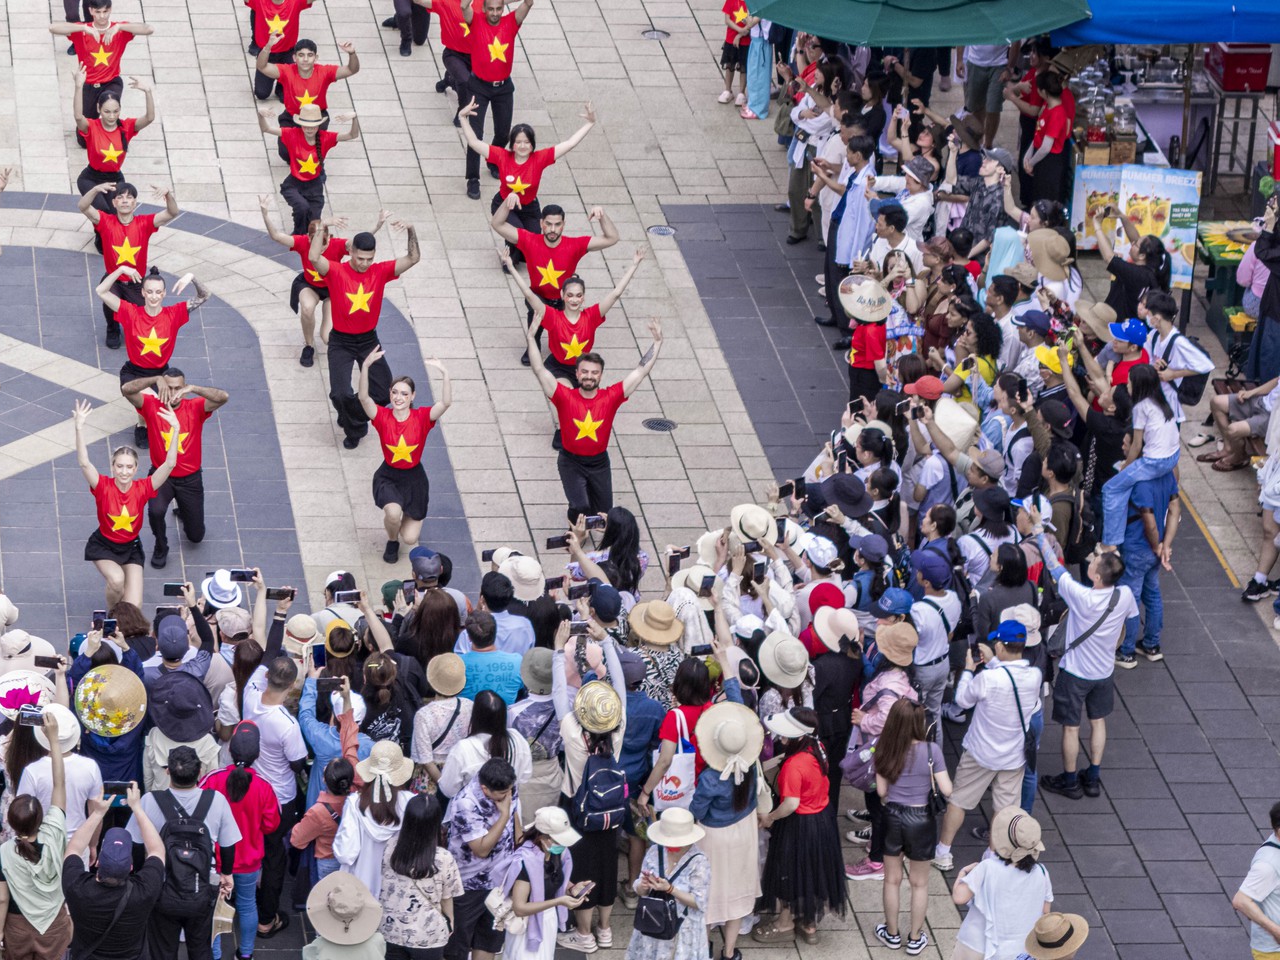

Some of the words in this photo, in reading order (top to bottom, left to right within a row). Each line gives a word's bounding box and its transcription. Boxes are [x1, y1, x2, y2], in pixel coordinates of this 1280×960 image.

[1122, 170, 1164, 184] SUMMER
[466, 663, 483, 673] st.
[486, 661, 515, 672] 1969
[484, 672, 514, 683] Calif.
[657, 789, 685, 801] Vietnam
